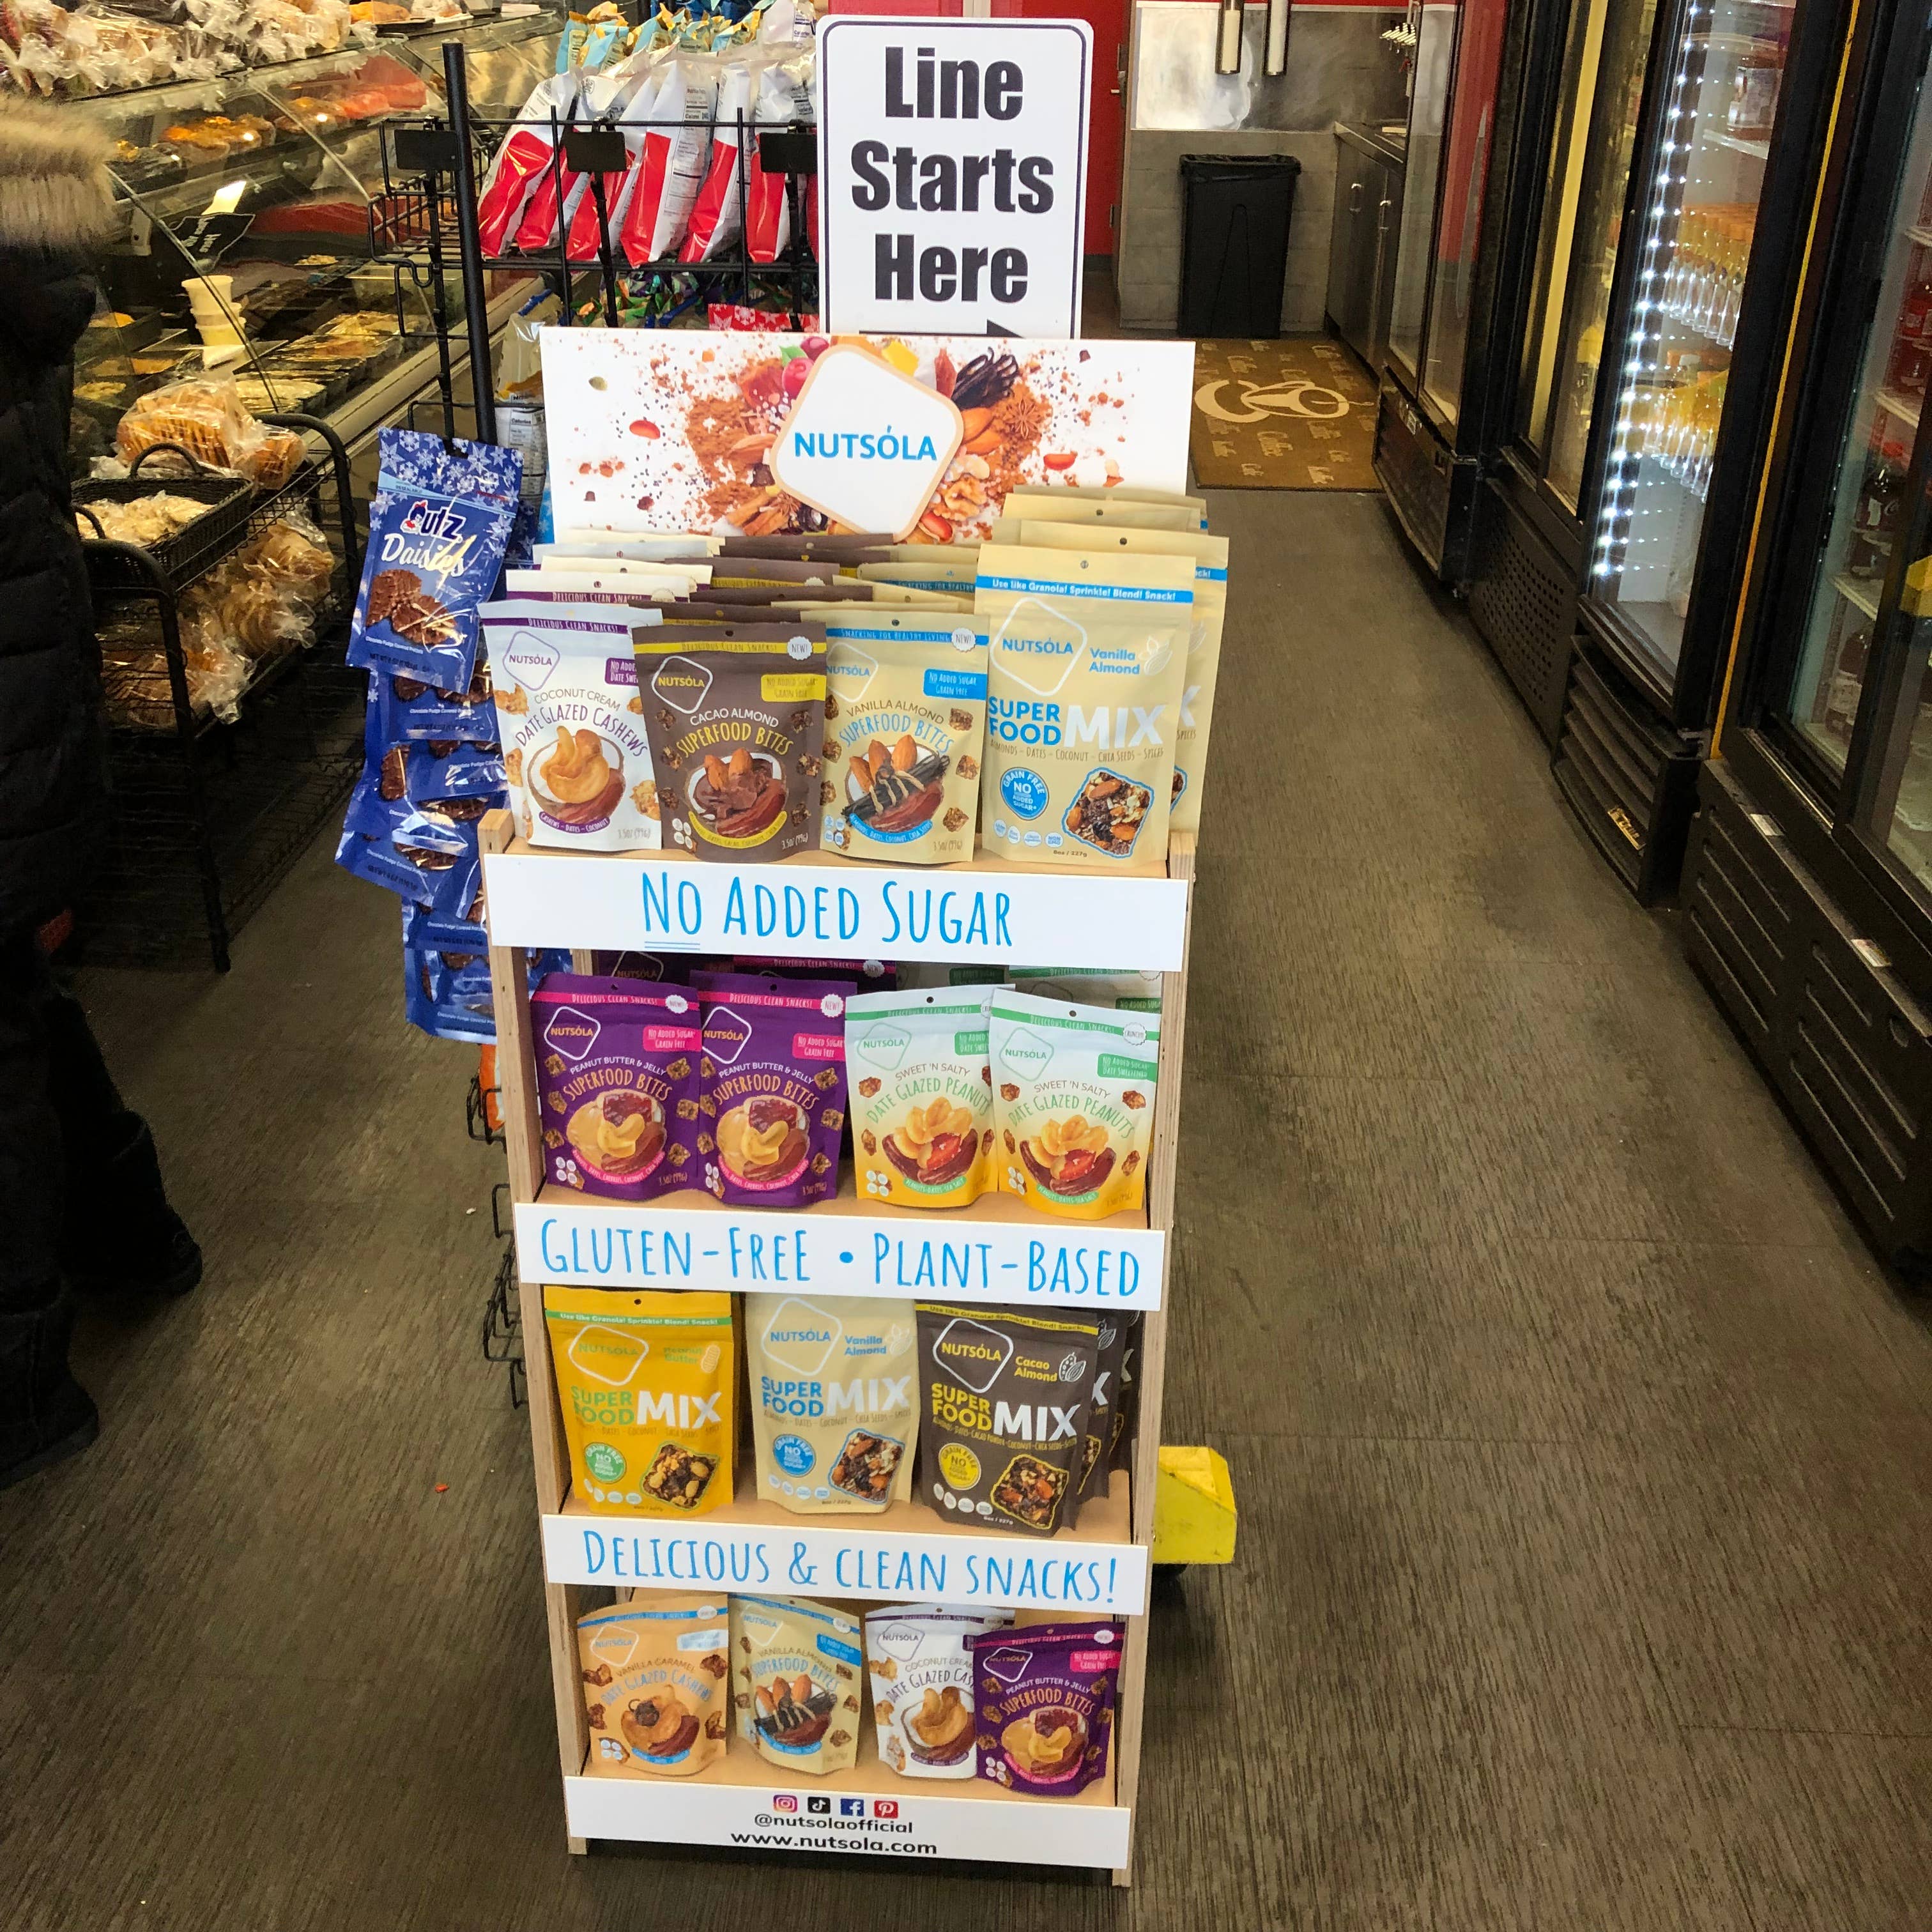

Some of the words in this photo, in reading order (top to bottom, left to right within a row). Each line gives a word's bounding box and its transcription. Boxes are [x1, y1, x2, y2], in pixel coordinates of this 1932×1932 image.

[885, 47, 1023, 121] Line
[851, 140, 1054, 214] Starts
[875, 234, 1028, 303] Here
[793, 424, 937, 461] NUTSÓLA
[992, 579, 1009, 588] Use
[1011, 579, 1027, 590] like
[1029, 581, 1068, 594] Granola!
[1070, 585, 1111, 597] Sprinkle!
[1113, 588, 1142, 599] Blend!
[1145, 591, 1176, 601] Snack!
[528, 618, 564, 629] DELICIOUS
[565, 620, 587, 631] CLEAN
[792, 643, 808, 654] NEW!
[955, 634, 971, 644] NEW!
[1002, 636, 1074, 656] NUTSÓLA
[509, 652, 553, 666] NUTSÓLA
[1089, 648, 1136, 661] Vanilla
[825, 664, 870, 677] NUTSÓLA
[1089, 661, 1140, 675] Almond
[658, 675, 705, 688] NUTSÓLA
[929, 674, 937, 684] NO
[939, 675, 957, 684] ADDED
[534, 689, 585, 704] COCONUT
[587, 690, 621, 712] CREAM
[988, 696, 1061, 723] SUPER
[690, 707, 730, 726] CACAO
[731, 708, 779, 728] ALMOND
[846, 700, 893, 717] VANILLA
[893, 700, 945, 724] ALMOND
[515, 716, 544, 747] DATE
[544, 704, 588, 724] GLAZED
[593, 707, 648, 757] CASHEWS
[839, 713, 912, 748] SUPERFOOD
[914, 719, 955, 755] BITES
[988, 717, 1062, 746] FOOD
[1064, 704, 1166, 751] MIX
[676, 721, 752, 758] SUPERFOOD
[755, 726, 794, 756] BITES
[1026, 747, 1046, 759] DATES
[1055, 749, 1089, 762] COCONUT
[1003, 770, 1025, 788] GRAIN
[1027, 774, 1045, 795] FREE
[1013, 781, 1032, 793] NO
[642, 871, 703, 937] NO
[722, 876, 861, 941] ADDED
[882, 880, 1014, 947] SUGAR
[730, 993, 762, 1004] DELICIOUS
[763, 995, 784, 1006] CLEAN
[786, 997, 813, 1008] SNACKS!
[824, 1000, 840, 1011] NEW!
[551, 1025, 594, 1037] NUTSÓLA
[703, 1029, 744, 1041] NUTSÓLA
[808, 1038, 825, 1047] ADDED
[863, 1038, 905, 1049] NUTSÓLA
[1005, 1048, 1047, 1059] NUTSÓLA
[570, 1058, 602, 1075] PEANUT
[604, 1056, 635, 1066] BUTTER
[643, 1062, 668, 1077] JELLY
[719, 1062, 751, 1078] PEANUT
[752, 1062, 784, 1074] BUTTER
[791, 1069, 815, 1084] JELLY
[895, 1064, 927, 1082] SWEET
[941, 1063, 970, 1077] SALTY
[563, 1068, 633, 1102] SUPERFOOD
[636, 1073, 673, 1102] BITES
[713, 1074, 781, 1105] SUPERFOOD
[783, 1080, 820, 1110] BITES
[1034, 1080, 1068, 1093] SWEET
[1080, 1082, 1111, 1099] SALTY
[866, 1093, 896, 1124] DATE
[896, 1077, 941, 1101] GLAZED
[1008, 1103, 1033, 1127] DATE
[1033, 1094, 1080, 1112] GLAZED
[1084, 1096, 1136, 1139] PEANUTS
[541, 1219, 811, 1282] GLUTEN-FREE
[873, 1232, 1140, 1297] PLANT-BASED
[770, 1328, 831, 1342] NUTSÓLA
[844, 1335, 883, 1345] Vanilla
[844, 1346, 887, 1356] Almond
[941, 1342, 1002, 1361] NUTSÓLA
[1015, 1356, 1050, 1370] Cacao
[1014, 1367, 1057, 1383] Almond
[571, 1386, 632, 1407] SUPER
[761, 1375, 822, 1398] SUPER
[826, 1375, 911, 1417] MIX
[762, 1392, 824, 1418] FOOD
[931, 1383, 990, 1414] SUPER
[572, 1401, 635, 1425] FOOD
[637, 1390, 722, 1429] MIX
[932, 1399, 992, 1431] FOOD
[993, 1400, 1081, 1442] MIX
[951, 1455, 967, 1468] NO
[583, 1530, 770, 1583] DELICIOUS
[788, 1541, 816, 1585] &
[836, 1549, 947, 1593] CLEAN
[965, 1555, 1117, 1602] SNACKS!
[617, 1659, 652, 1677] VANILLA
[656, 1657, 696, 1673] CARAMEL
[1006, 1679, 1034, 1695] PEANUT
[1035, 1677, 1064, 1685] BUTTER
[1071, 1681, 1092, 1694] JELLY
[999, 1688, 1062, 1716] SUPERFOOD
[1065, 1690, 1096, 1717] BITES
[754, 1813, 914, 1834] @nutsolaofficial
[730, 1832, 938, 1855] www.nutsola.com
